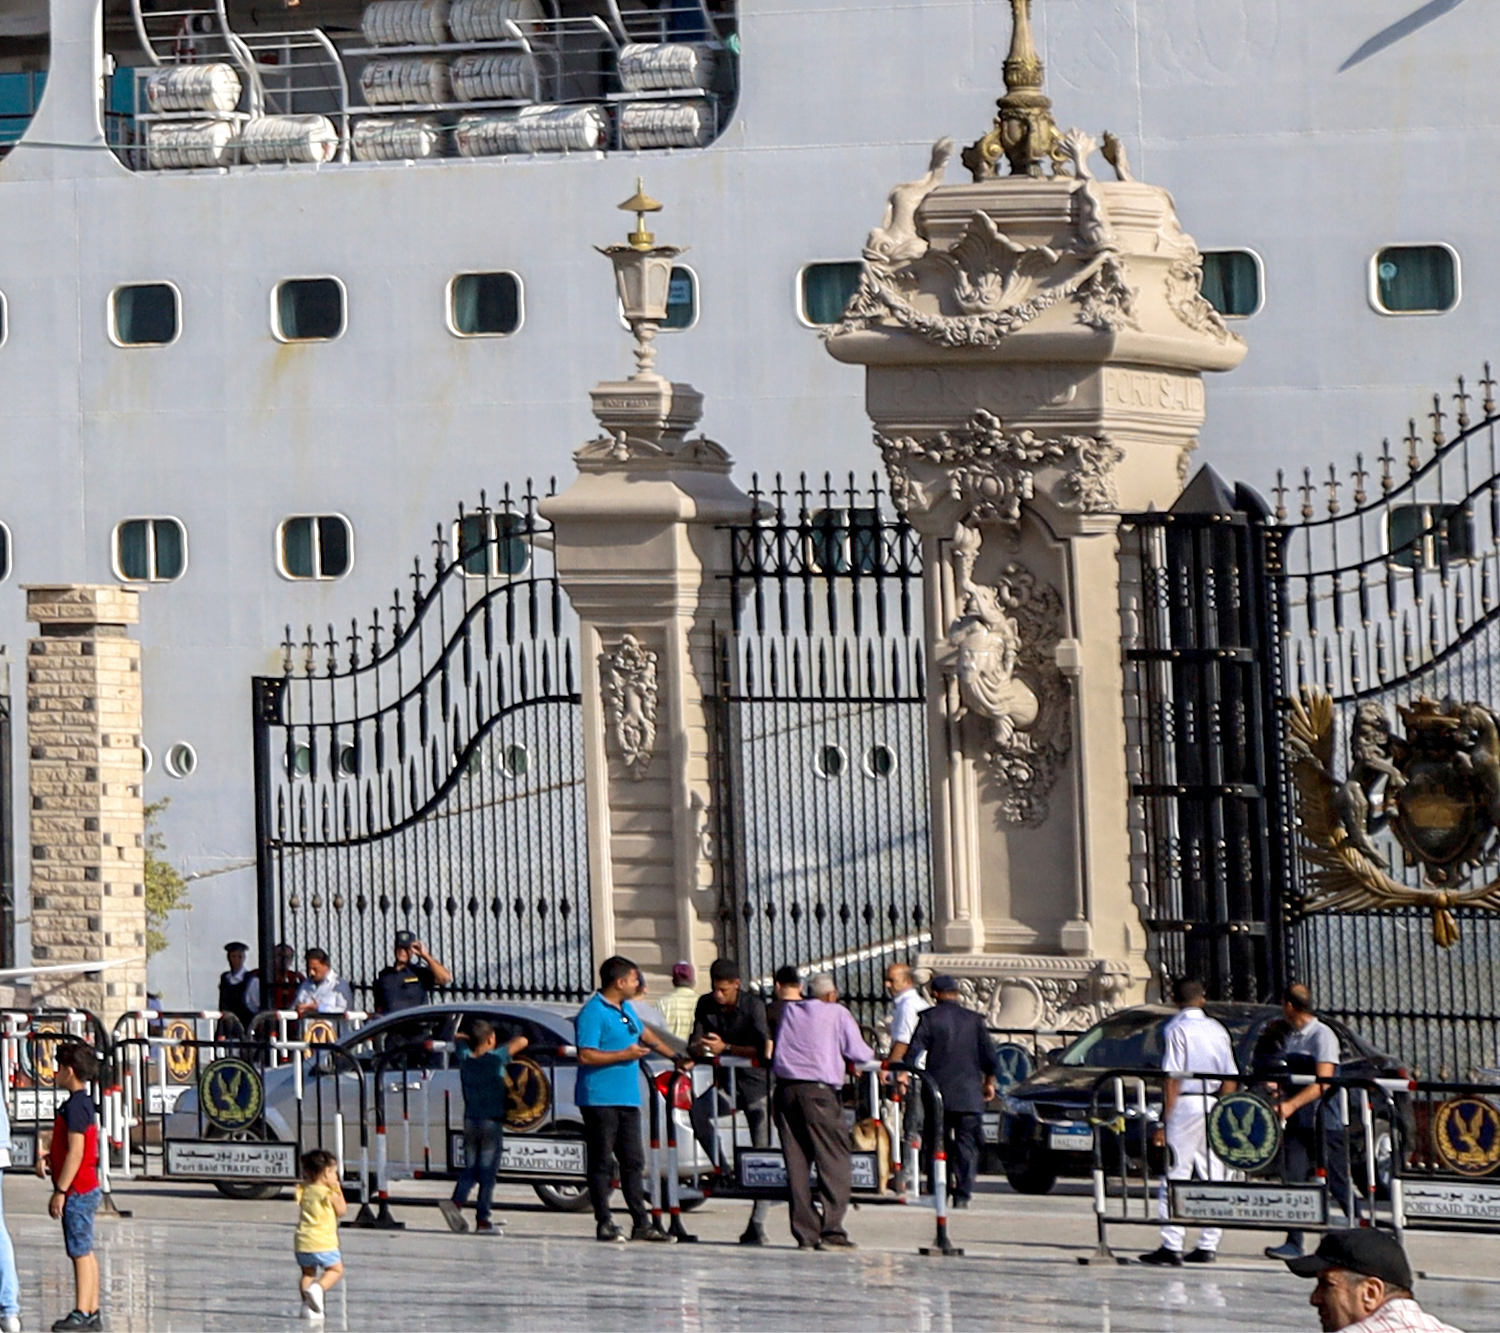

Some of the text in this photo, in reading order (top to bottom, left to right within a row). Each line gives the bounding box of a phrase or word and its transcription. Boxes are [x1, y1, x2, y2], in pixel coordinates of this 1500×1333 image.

[512, 1156, 554, 1169] TRAFFIC
[176, 1163, 290, 1175] Port Said TRAFFIC DEPT
[1405, 1201, 1432, 1213] PORT
[1436, 1204, 1463, 1214] SAID
[1185, 1208, 1316, 1220] Port Said TRAFFIC DEPT
